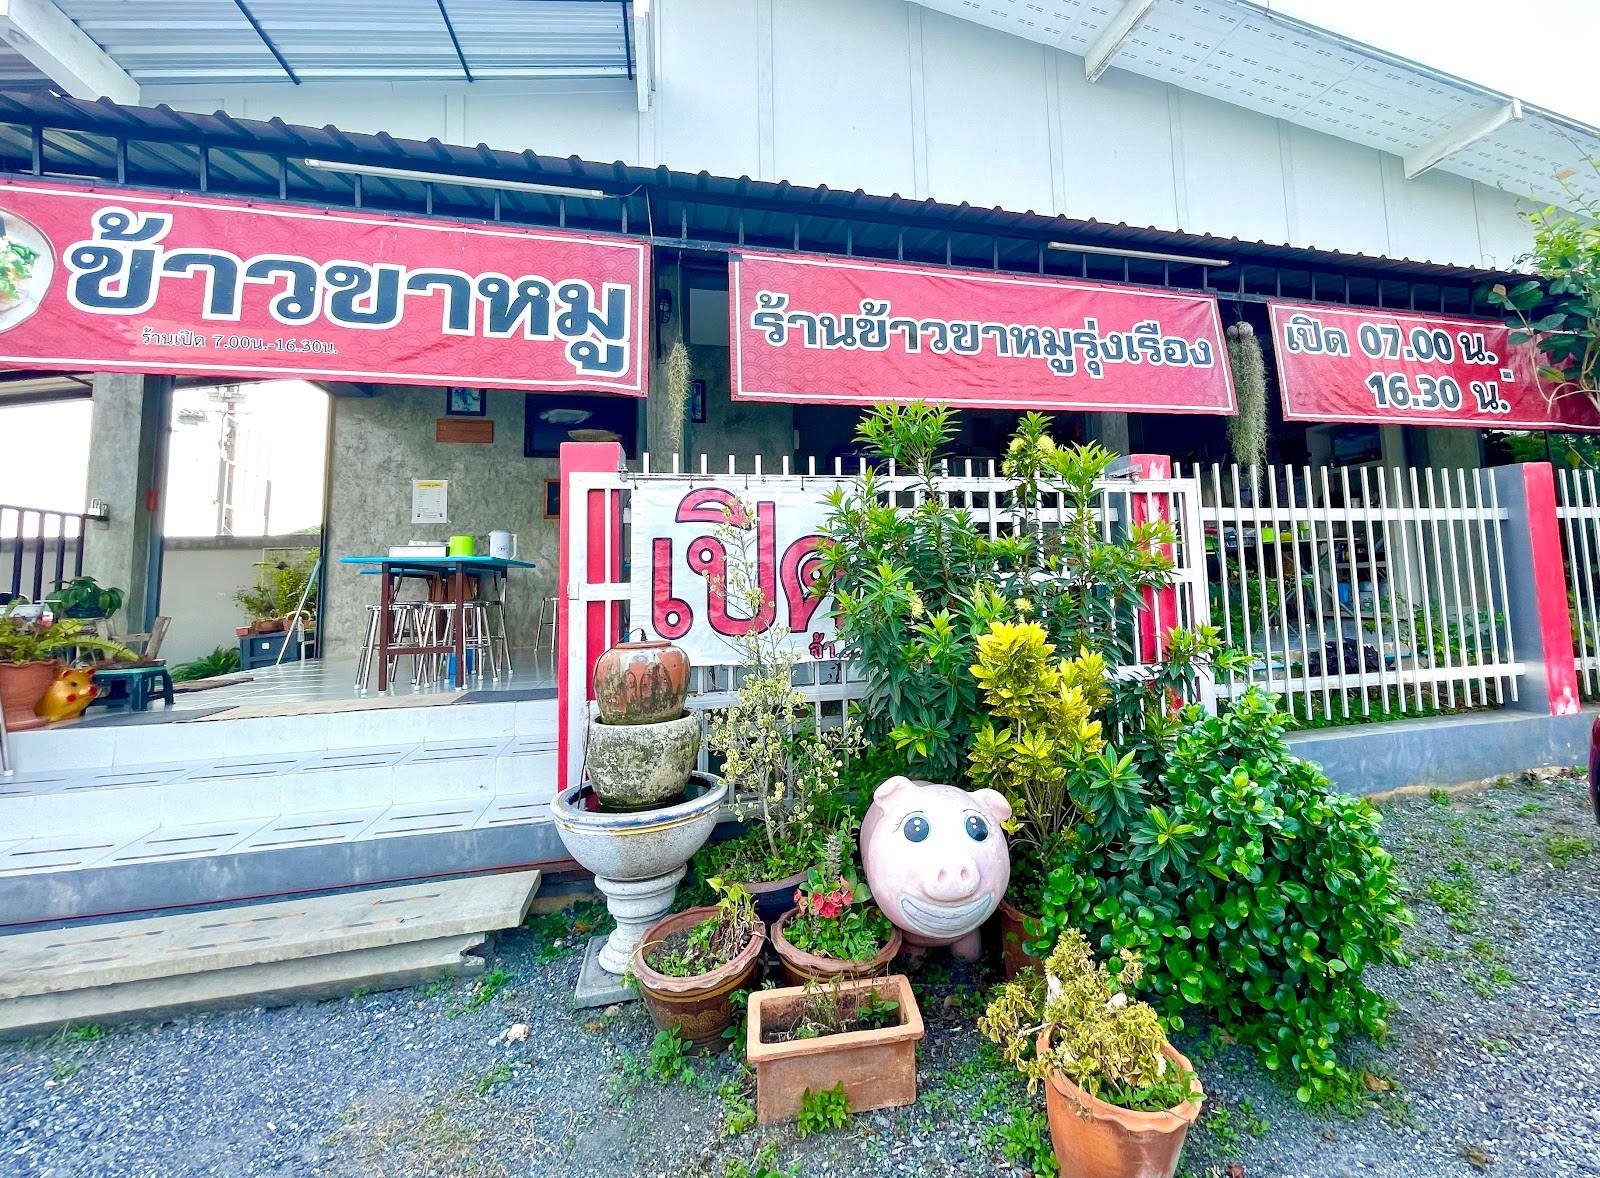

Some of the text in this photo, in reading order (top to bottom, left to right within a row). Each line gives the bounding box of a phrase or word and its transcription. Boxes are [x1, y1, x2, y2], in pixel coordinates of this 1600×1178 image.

[63, 207, 631, 378] ข้าวขาหมู
[141, 327, 339, 355] ร้านเปิด 7.00น.-16.30น.
[751, 290, 1215, 379] ร้านข้าวขาหมูรุ่งเรือง
[1284, 314, 1351, 357] เปิด
[1358, 322, 1454, 364] 07.00
[1458, 332, 1498, 365] น.
[1365, 371, 1511, 413] 16.30 น.
